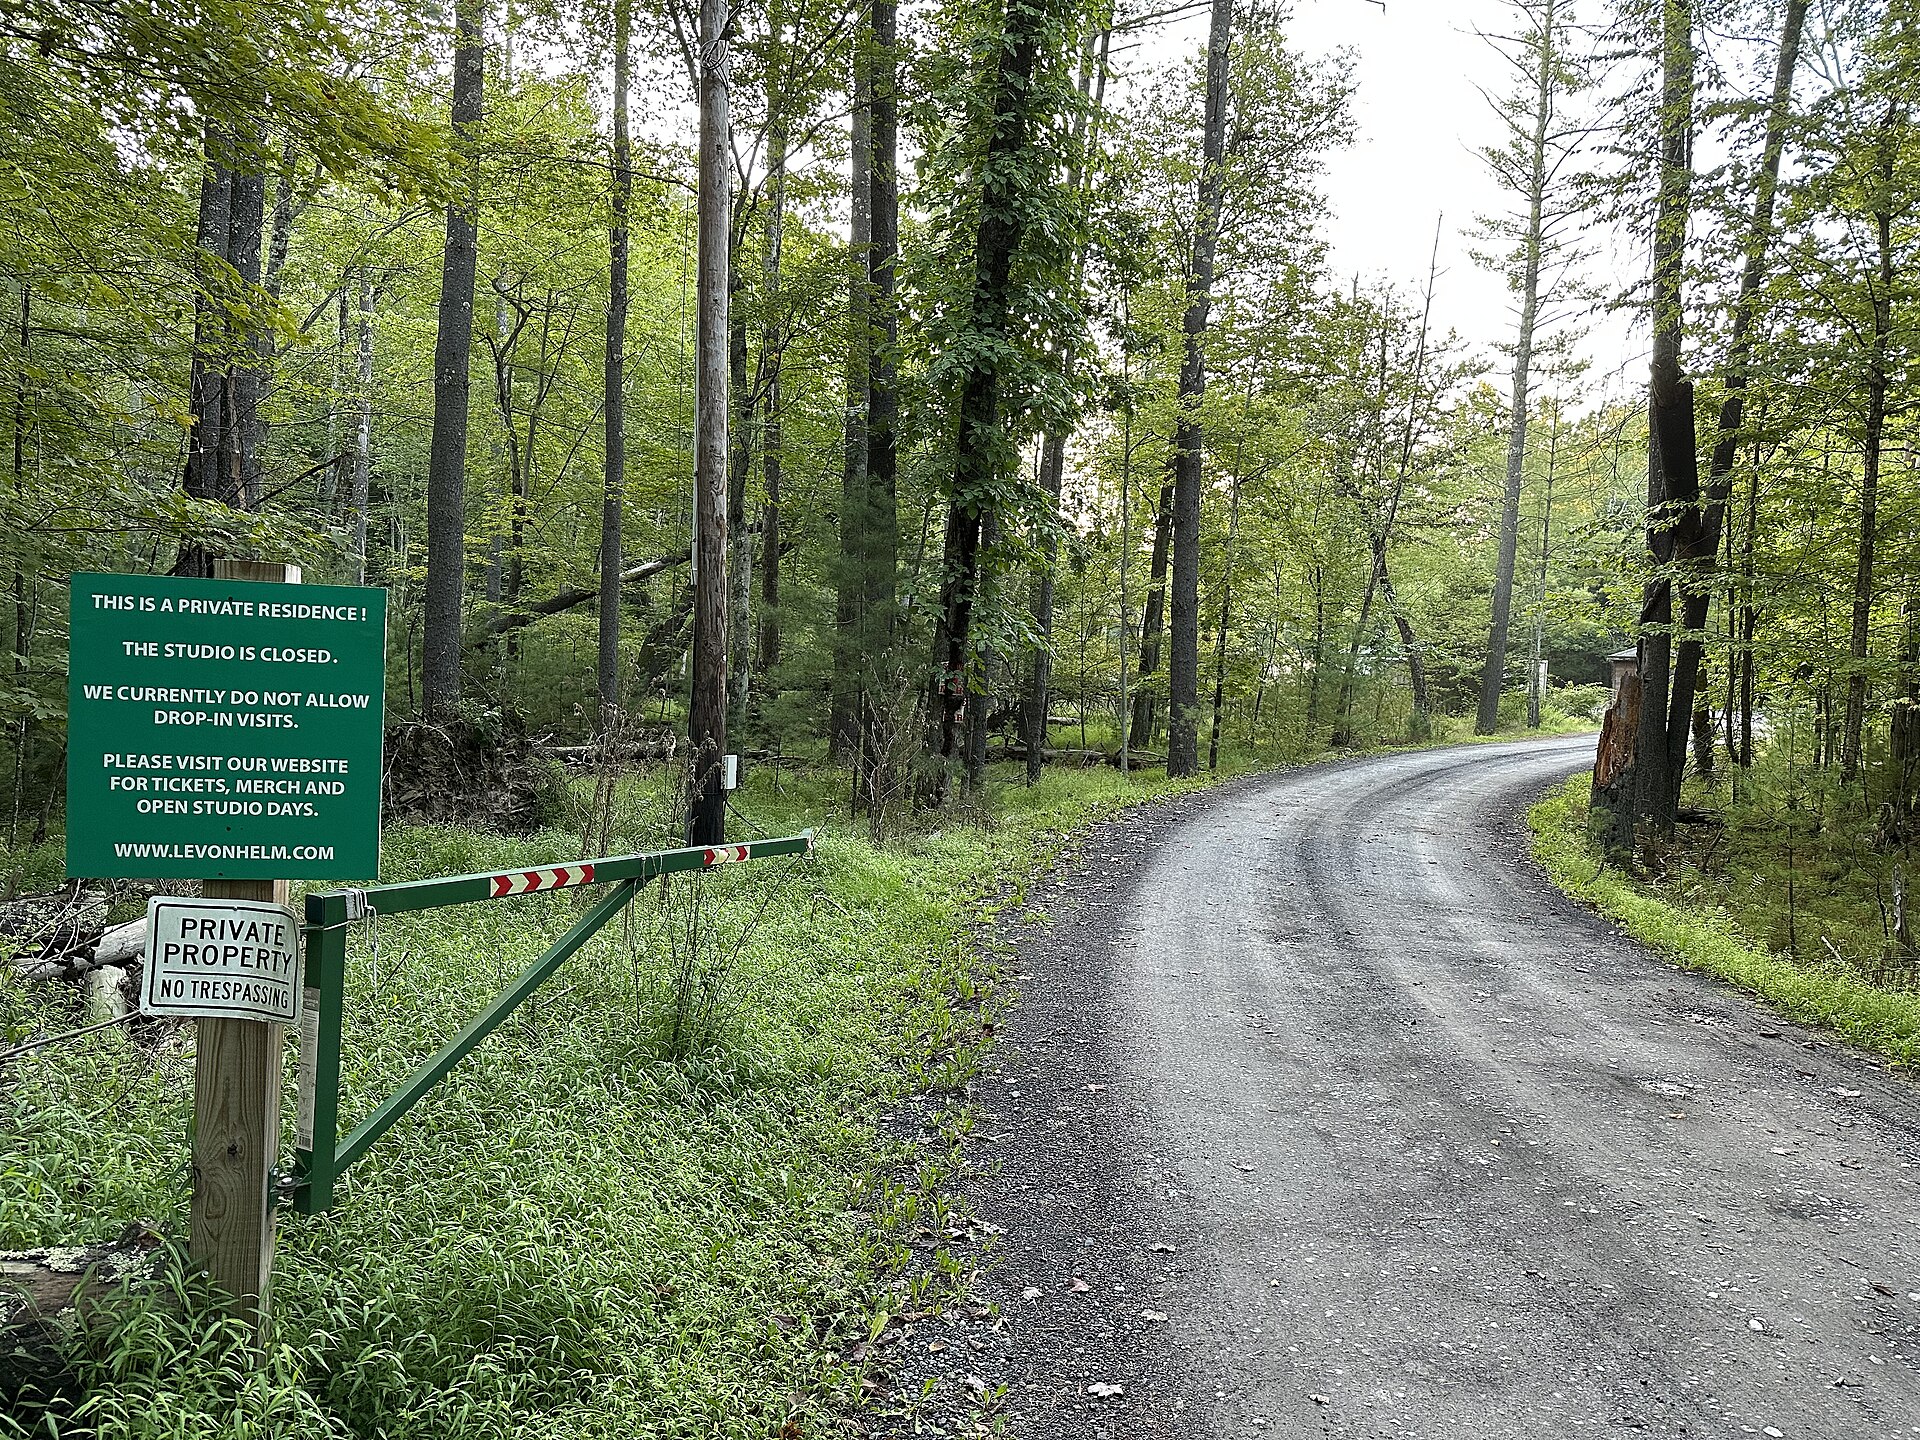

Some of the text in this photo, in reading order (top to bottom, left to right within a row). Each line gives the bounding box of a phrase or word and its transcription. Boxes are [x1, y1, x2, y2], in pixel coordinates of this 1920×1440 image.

[91, 594, 135, 611] THIS
[139, 596, 156, 612] IS
[160, 598, 174, 613] A
[178, 598, 254, 617] PRIVATE
[122, 641, 338, 664] THE STUDIO IS CLOSED.
[83, 684, 370, 709] WE CURRENTLY DO NOT ALLOW
[154, 710, 299, 729] DROP-IN VISITS.
[103, 753, 349, 774] PLEASE VISIT OUR WEBSITE
[110, 776, 345, 796] FOR TICKETS, MERCH AND
[136, 799, 319, 817] OPEN STUDIO DAYS.
[114, 843, 334, 860] WWW.LEVONHELM.COM
[180, 917, 286, 947] PRIVATE
[163, 942, 293, 975] PROPERTY
[160, 979, 185, 999] NO
[190, 980, 289, 1010] TRESPASSING
